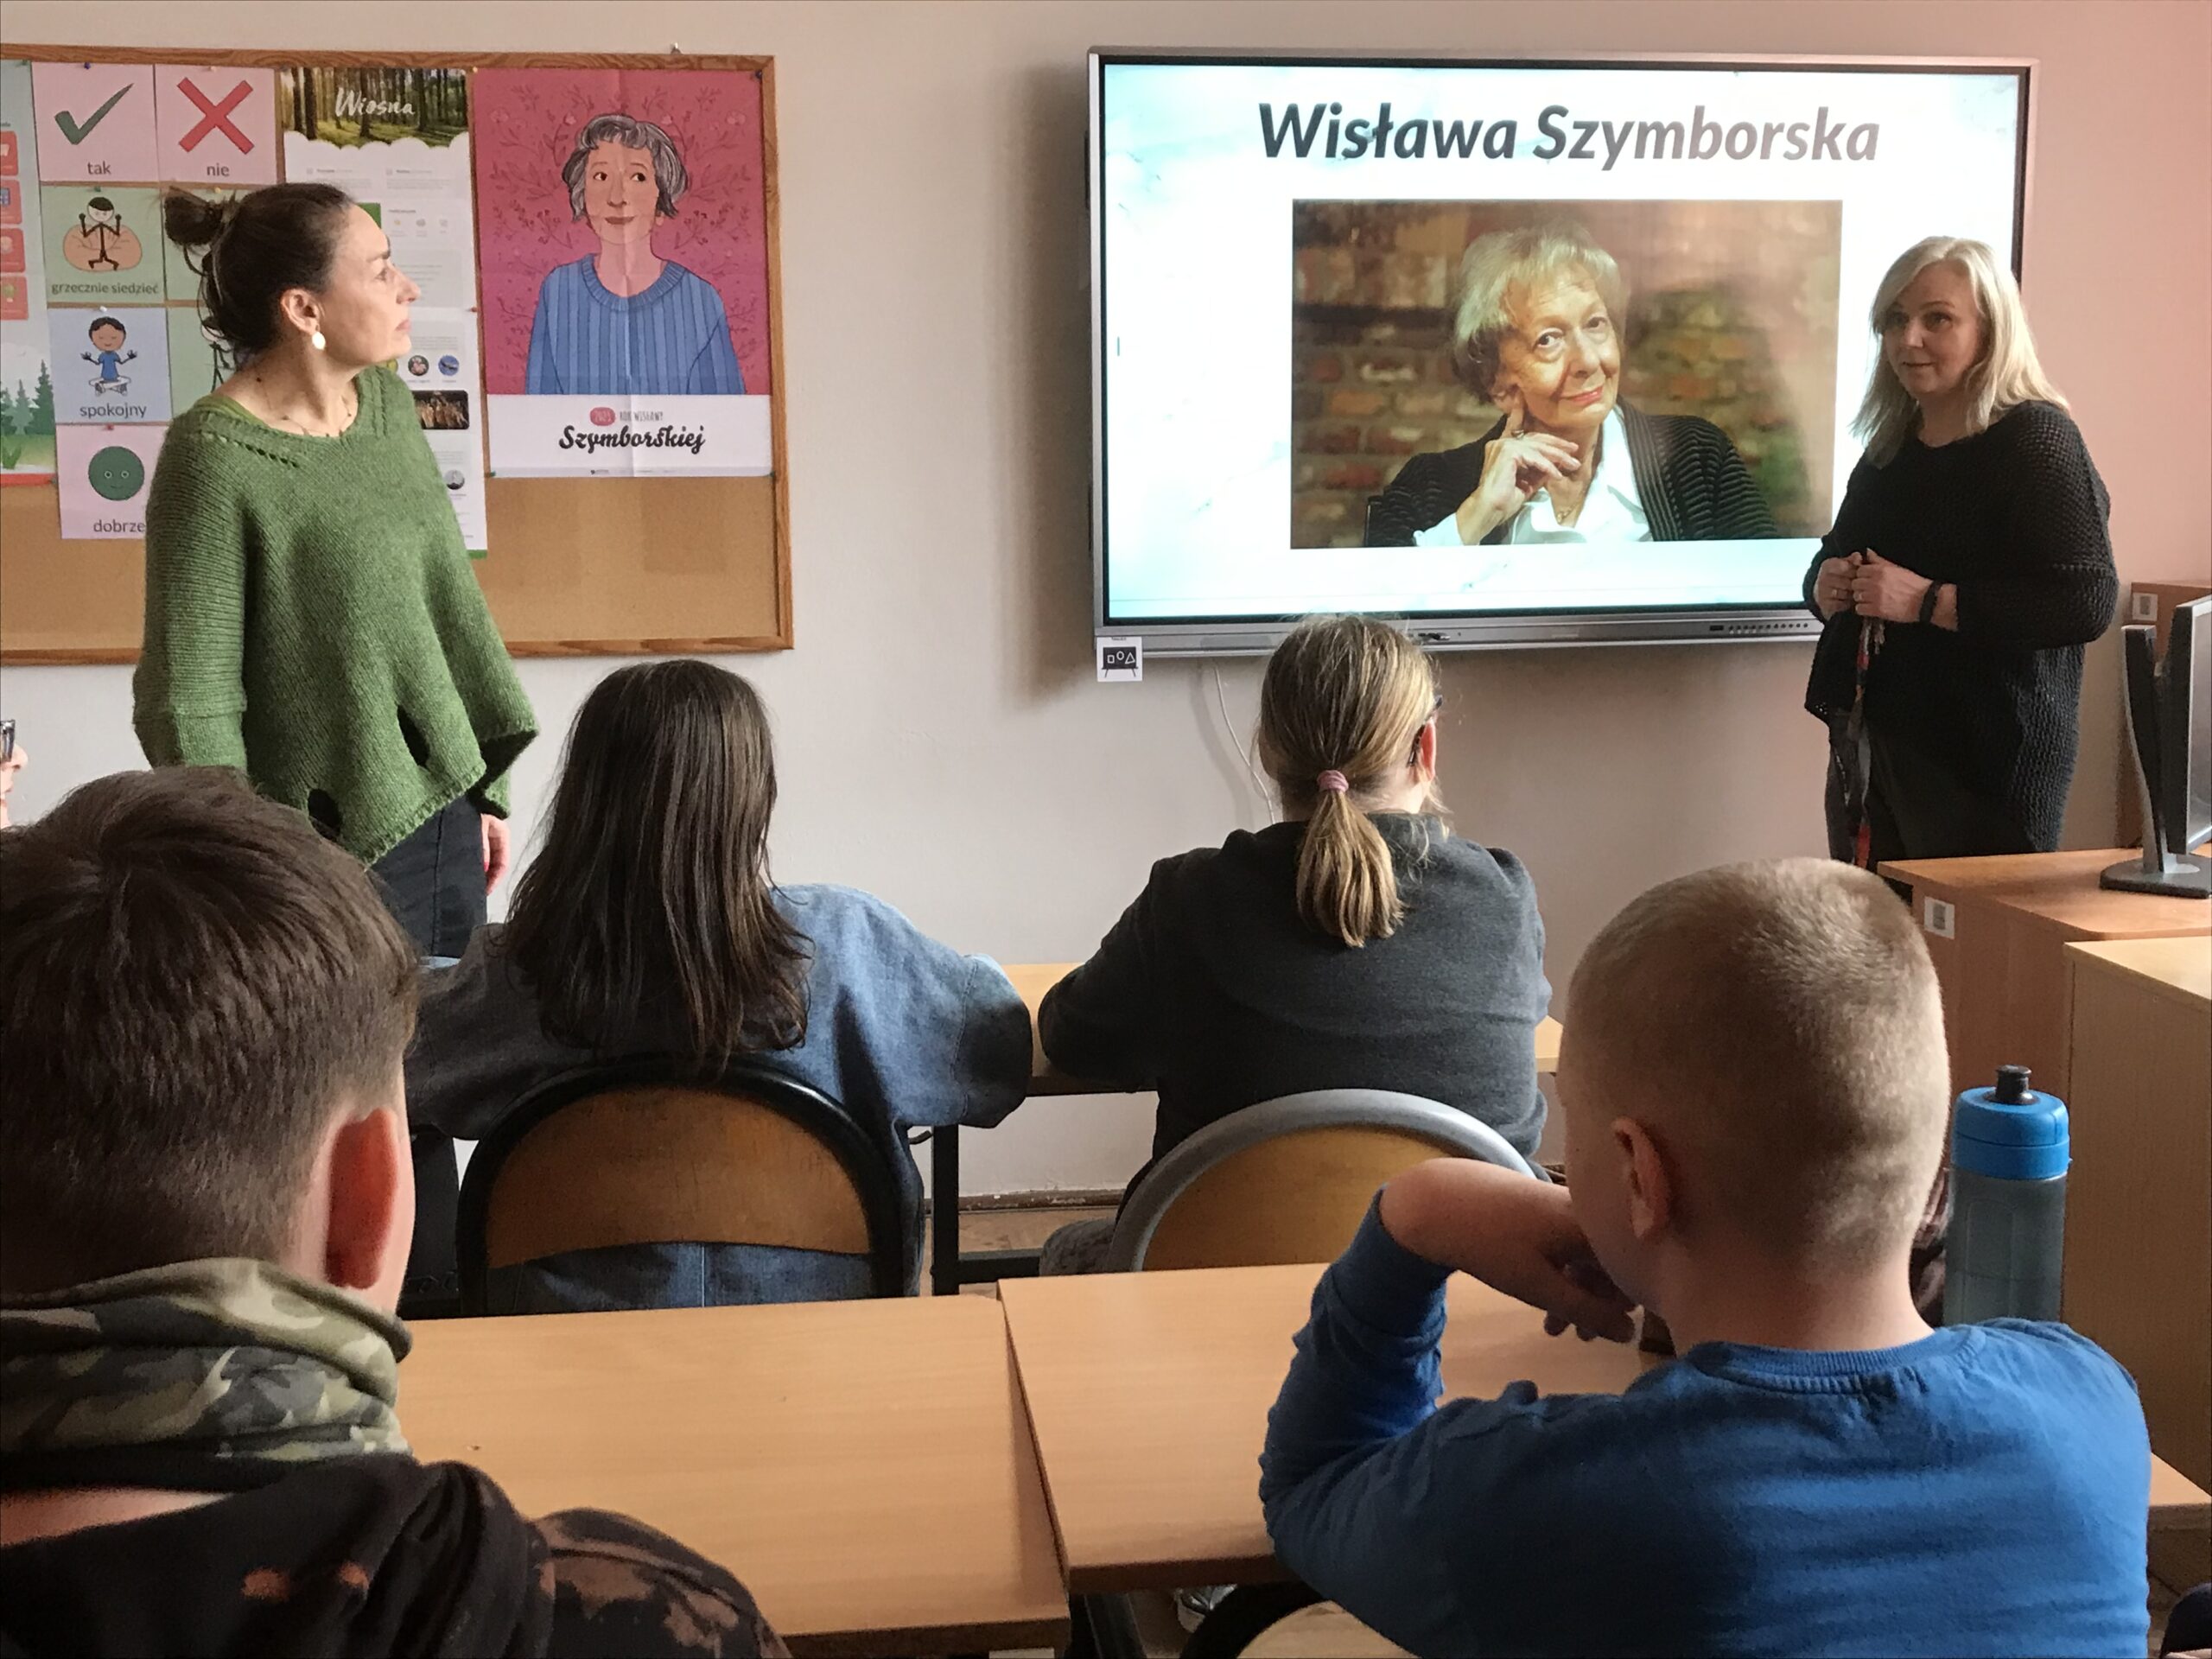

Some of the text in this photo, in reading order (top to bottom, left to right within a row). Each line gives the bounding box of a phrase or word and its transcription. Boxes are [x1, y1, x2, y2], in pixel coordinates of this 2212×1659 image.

[335, 87, 416, 118] Wiosna
[1258, 101, 1880, 171] Wisława Szymborska
[87, 161, 111, 175] tak
[207, 164, 230, 177] nie
[52, 282, 159, 296] grzecznie siedzieć
[79, 403, 147, 419] spokojny
[559, 424, 706, 454] Szymborskiej
[93, 518, 146, 533] dobrze
